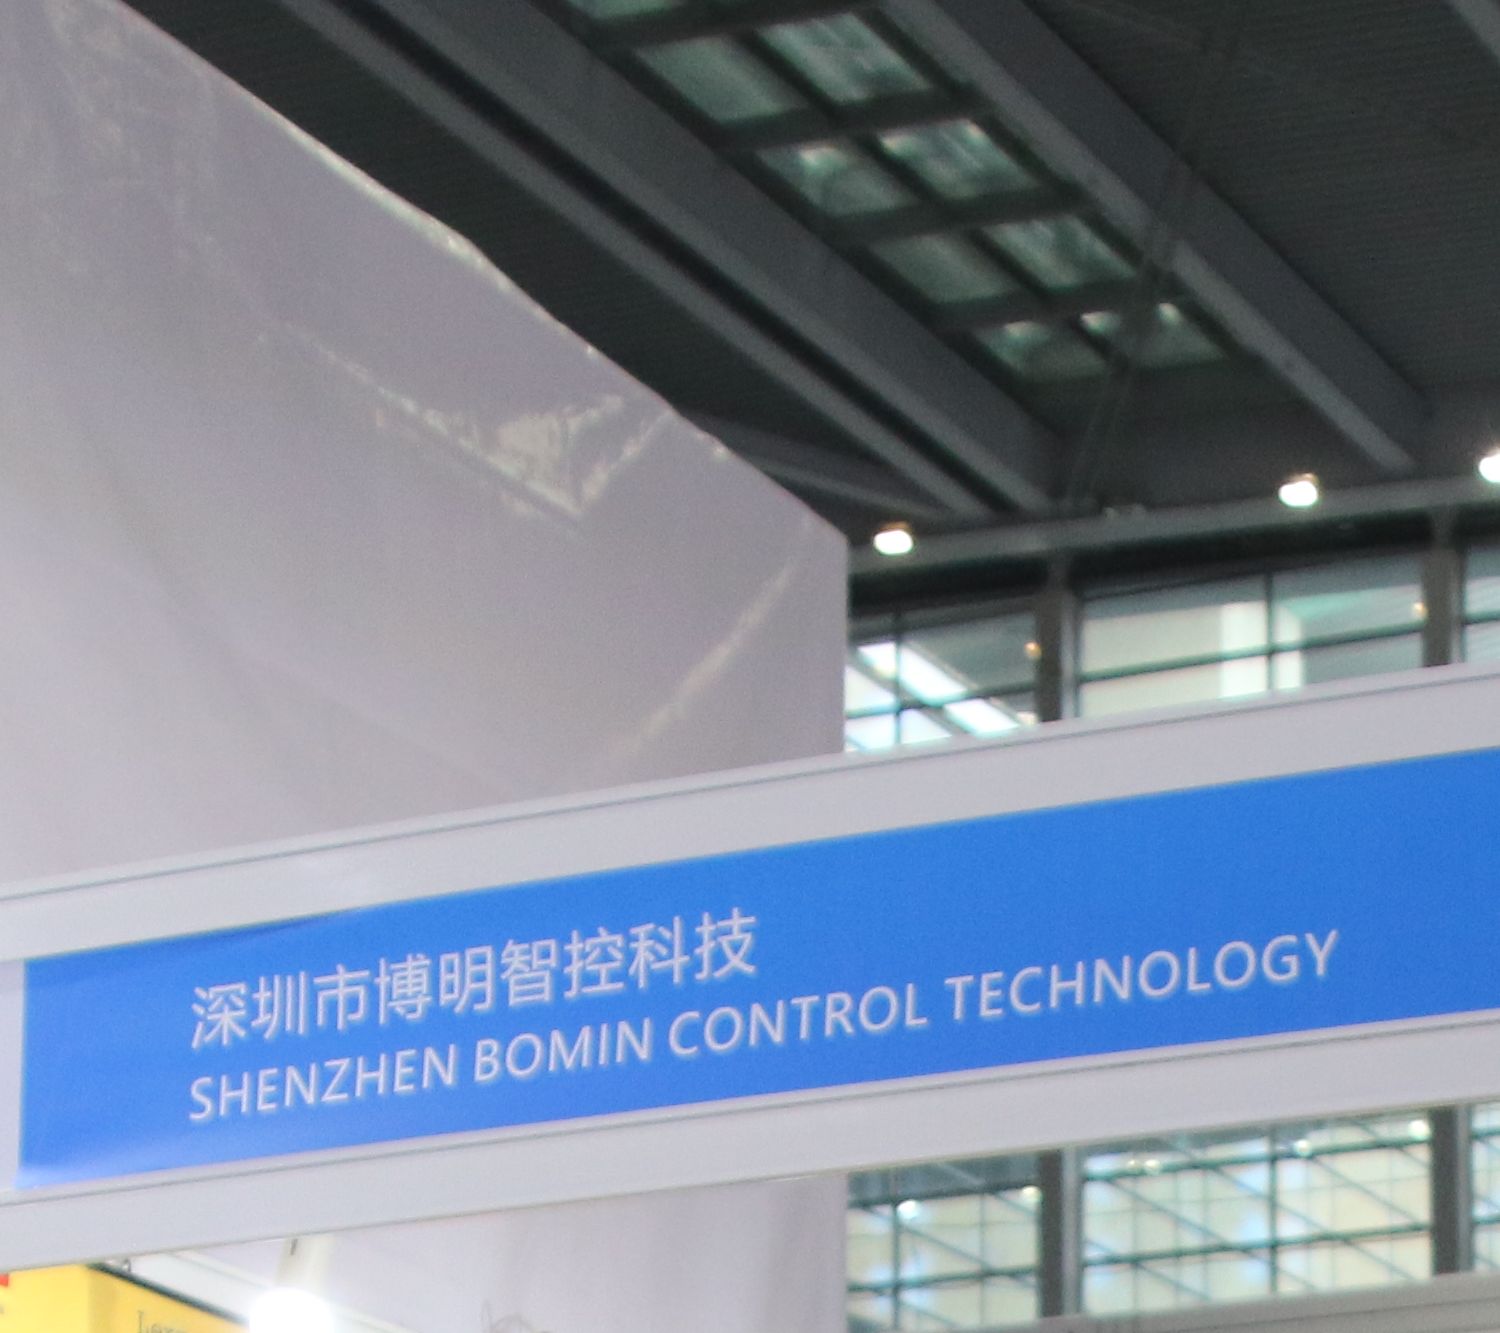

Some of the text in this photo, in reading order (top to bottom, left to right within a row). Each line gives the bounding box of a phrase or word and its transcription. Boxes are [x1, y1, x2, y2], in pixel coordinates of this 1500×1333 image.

[188, 928, 1342, 1122] SHENZHEN BOMIN CONTROL TECHNOLOGY
[190, 908, 758, 1050] 深圳市博明智控科技
